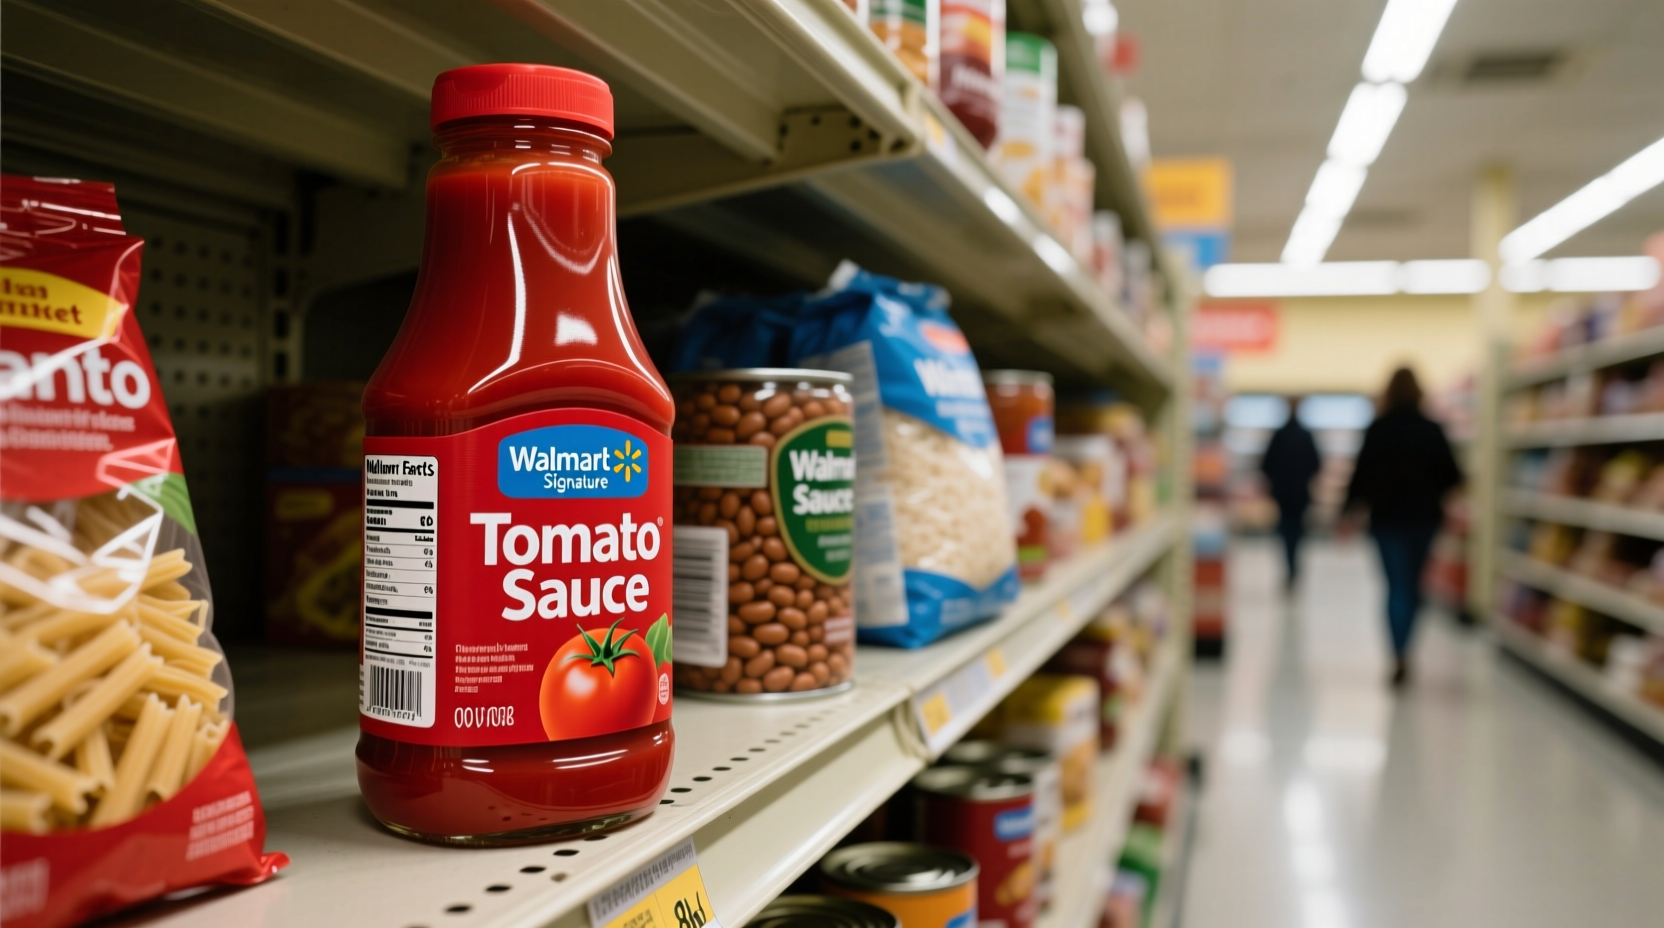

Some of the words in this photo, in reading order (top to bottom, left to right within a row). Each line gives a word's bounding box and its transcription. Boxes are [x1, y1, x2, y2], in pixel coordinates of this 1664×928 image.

[509, 446, 611, 472] Walmart
[543, 473, 609, 493] Signature
[470, 512, 661, 566] Tomato
[501, 568, 650, 622] Sauce
